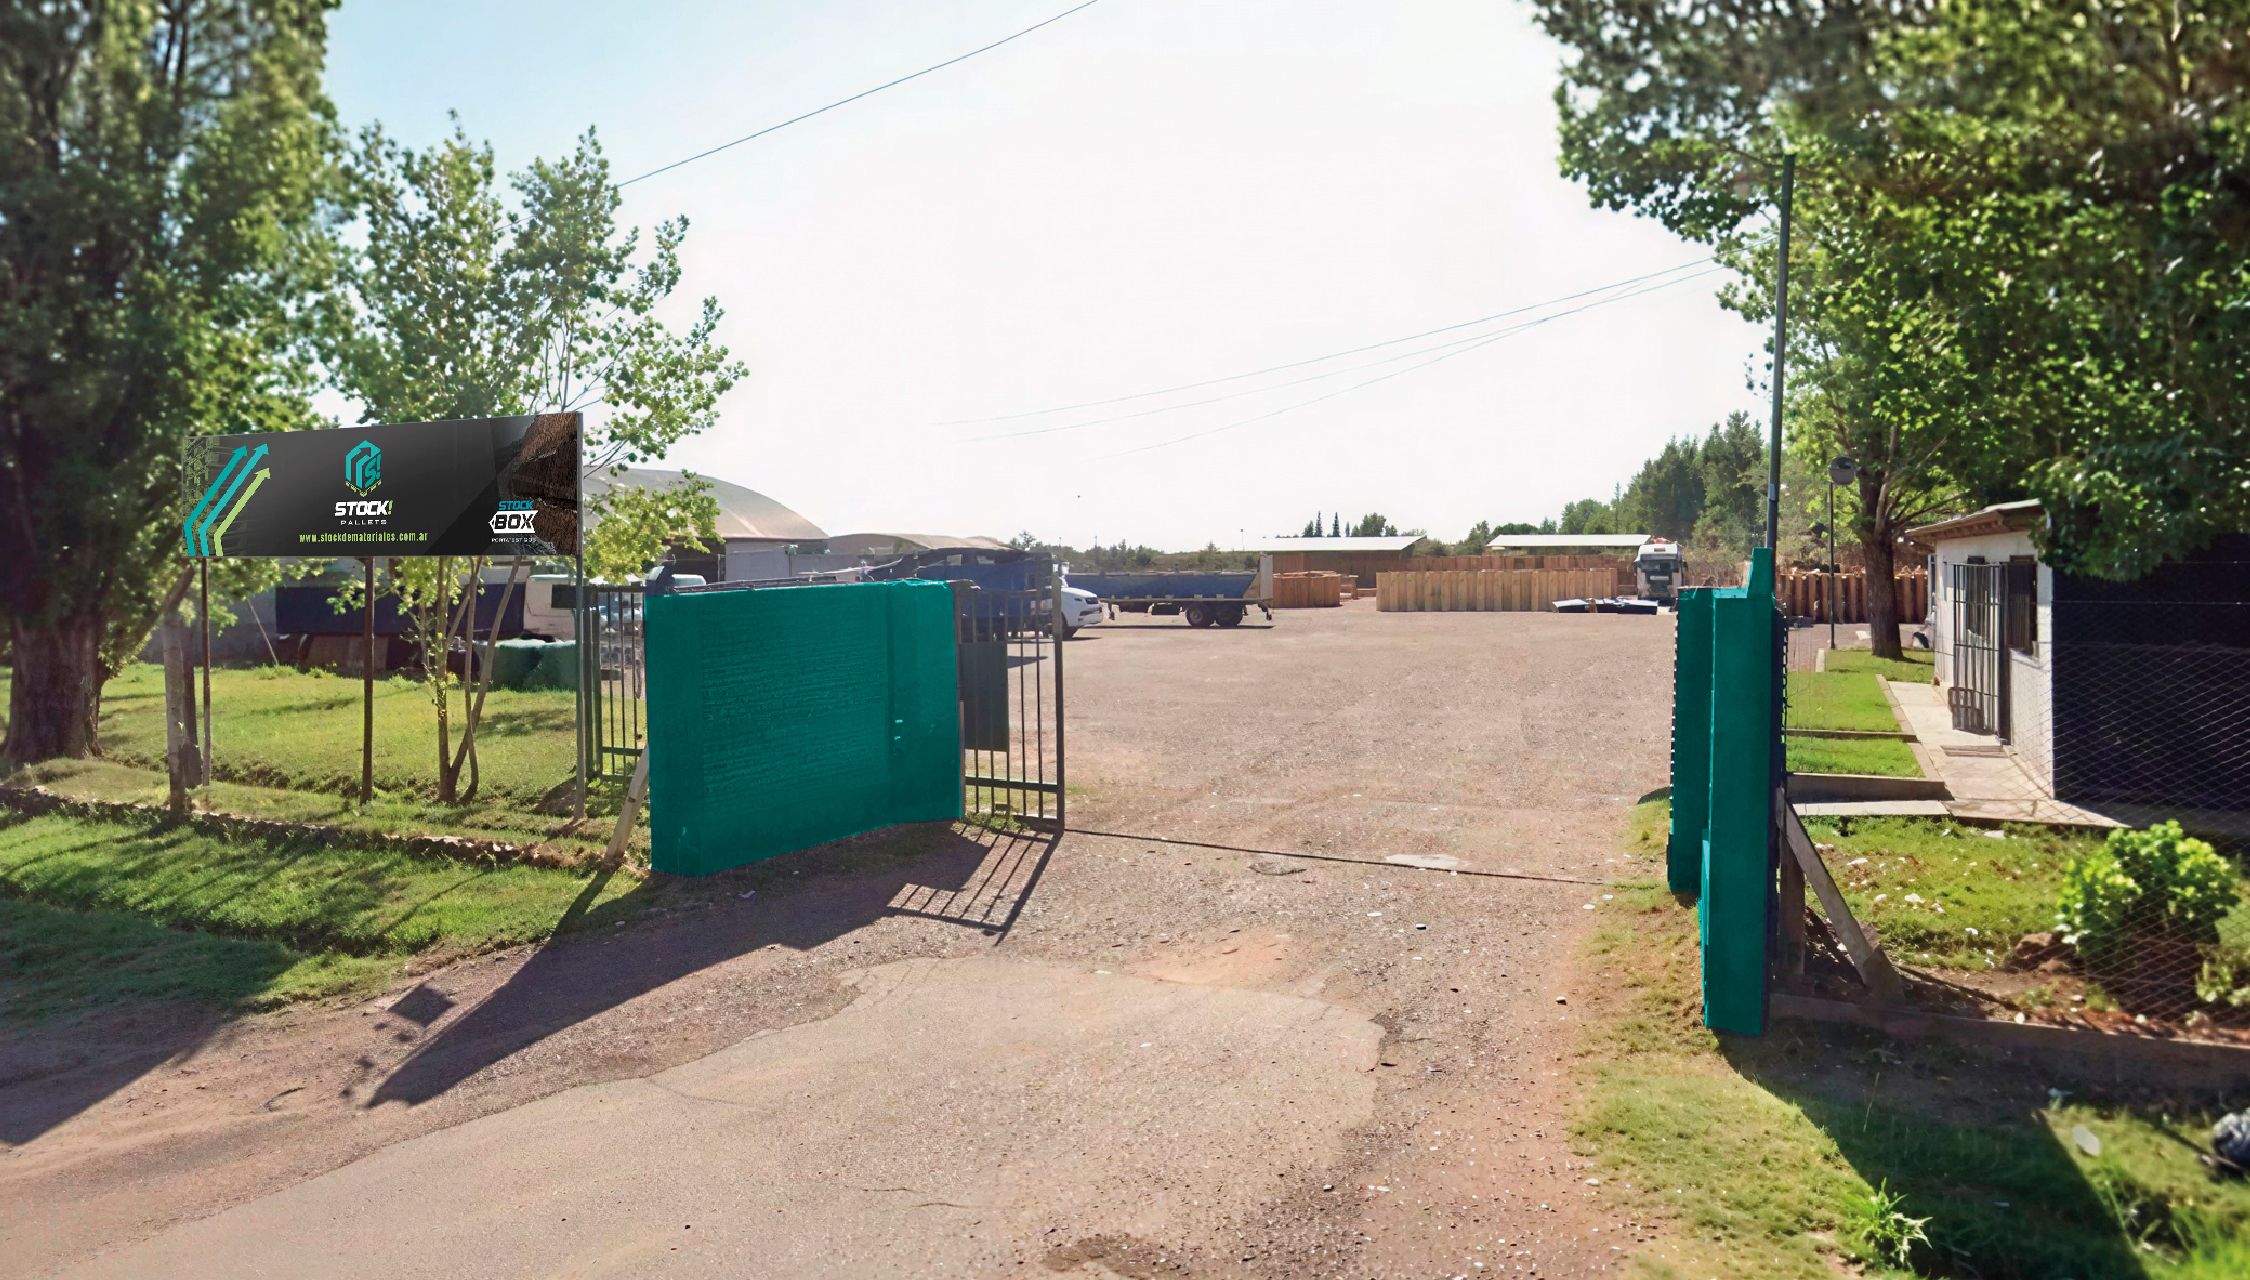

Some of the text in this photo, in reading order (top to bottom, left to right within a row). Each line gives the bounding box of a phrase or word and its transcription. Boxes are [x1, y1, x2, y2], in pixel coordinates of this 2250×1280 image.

[334, 500, 393, 516] STOCK!
[498, 500, 534, 510] STOCK
[494, 513, 534, 530] BOX
